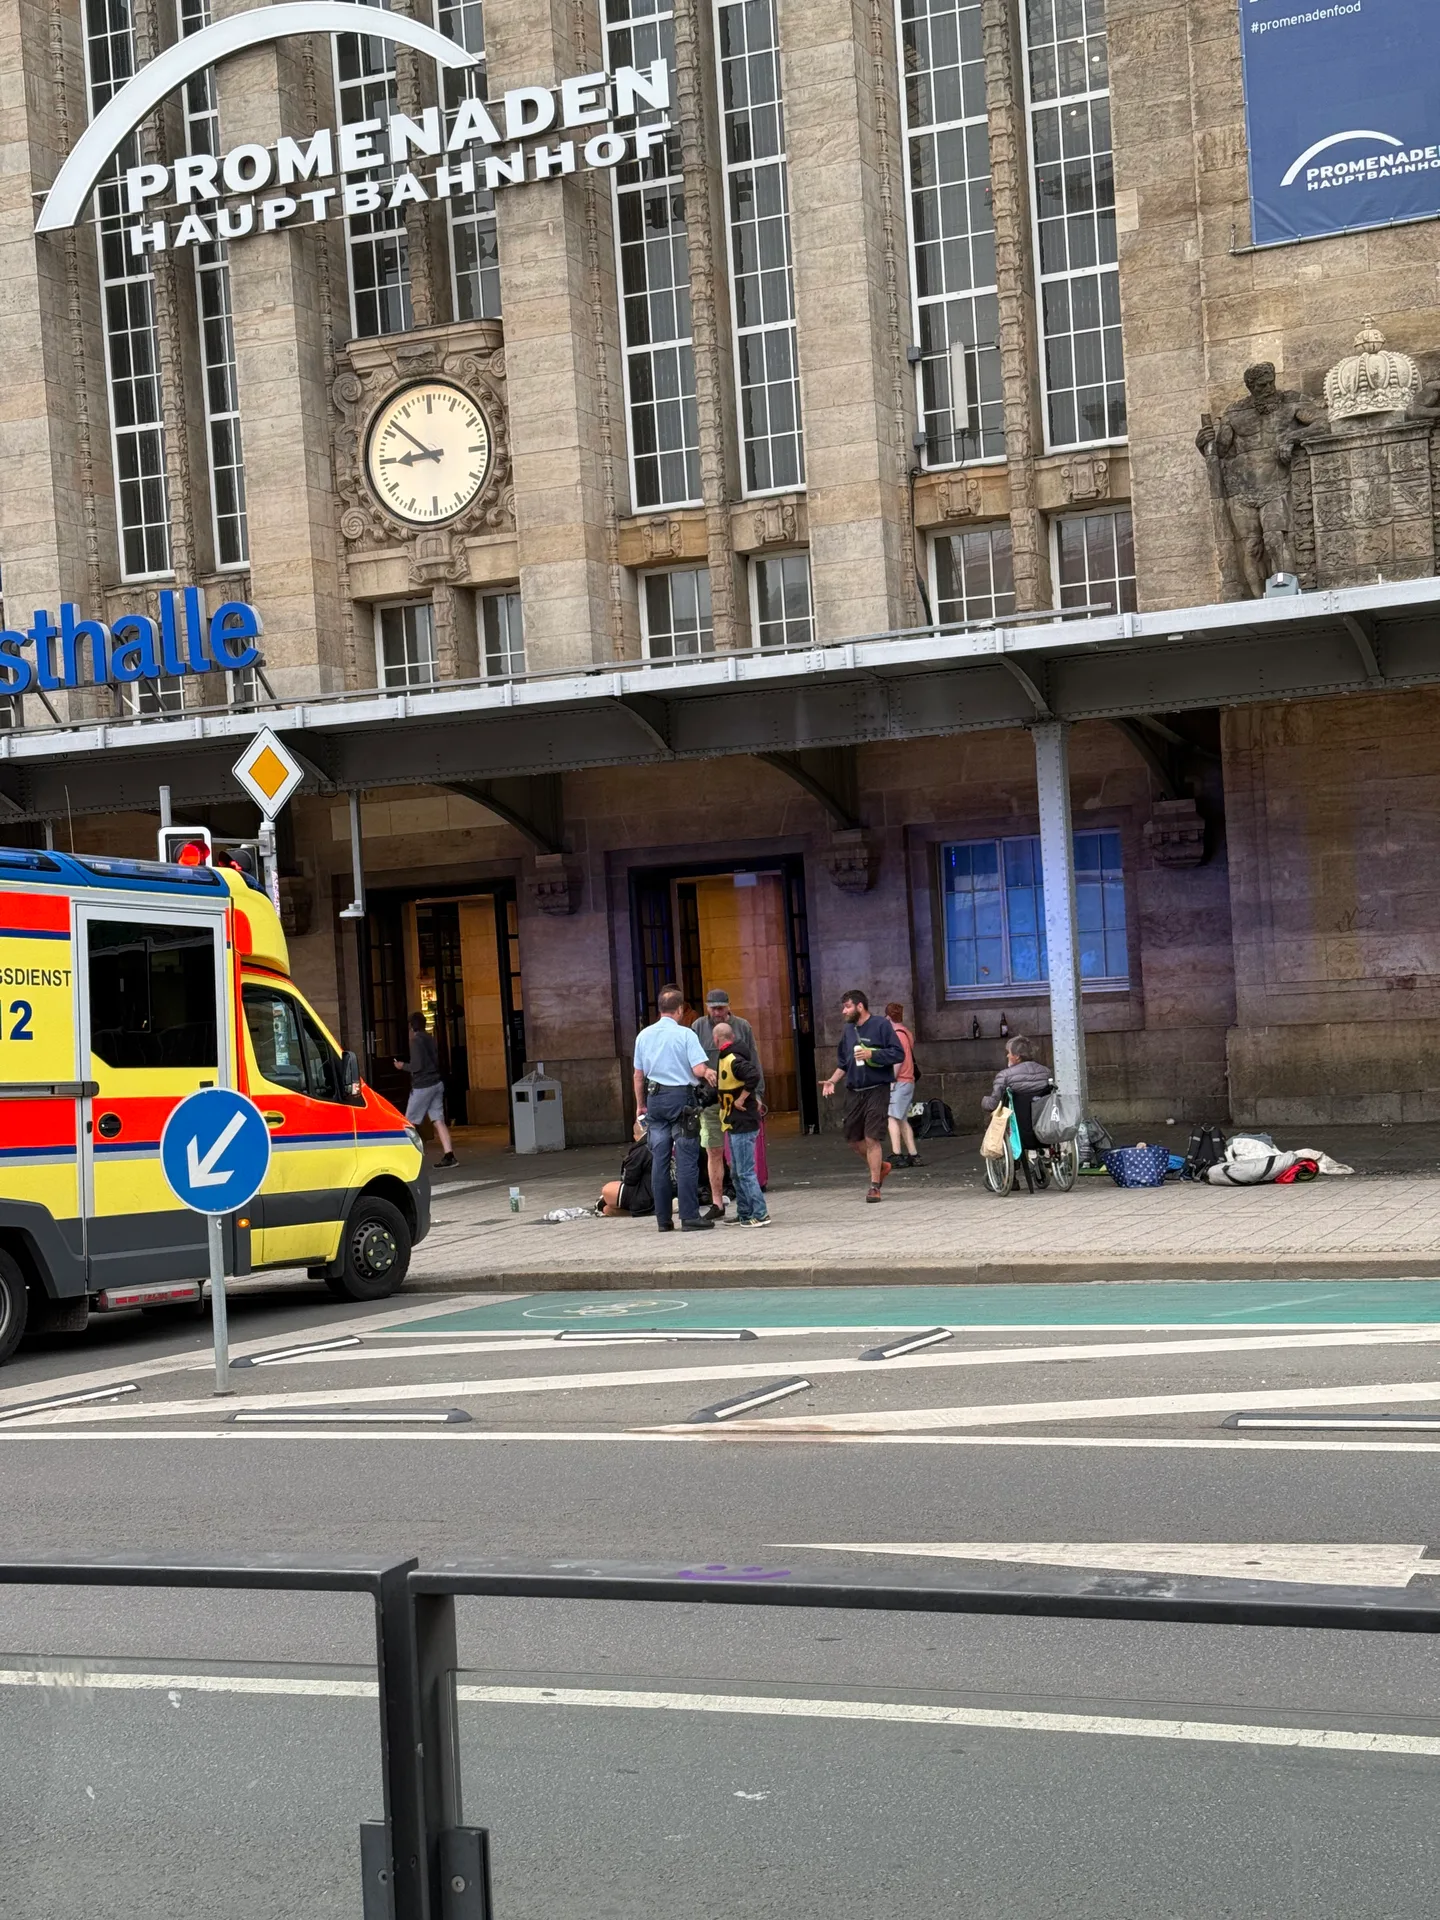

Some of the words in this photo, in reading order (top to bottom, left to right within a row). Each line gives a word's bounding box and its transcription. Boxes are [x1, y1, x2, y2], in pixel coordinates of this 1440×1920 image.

[1250, 0, 1362, 34] #promenadenfood
[126, 58, 673, 213] PROMENADEN
[1306, 145, 1440, 181] PROMENADE
[1307, 159, 1440, 191] HAUPTBAHNHO
[130, 122, 673, 256] HAUPTBAHNHOF
[0, 586, 263, 695] sthalle
[0, 967, 72, 987] SDIENST
[0, 999, 33, 1041] 2
